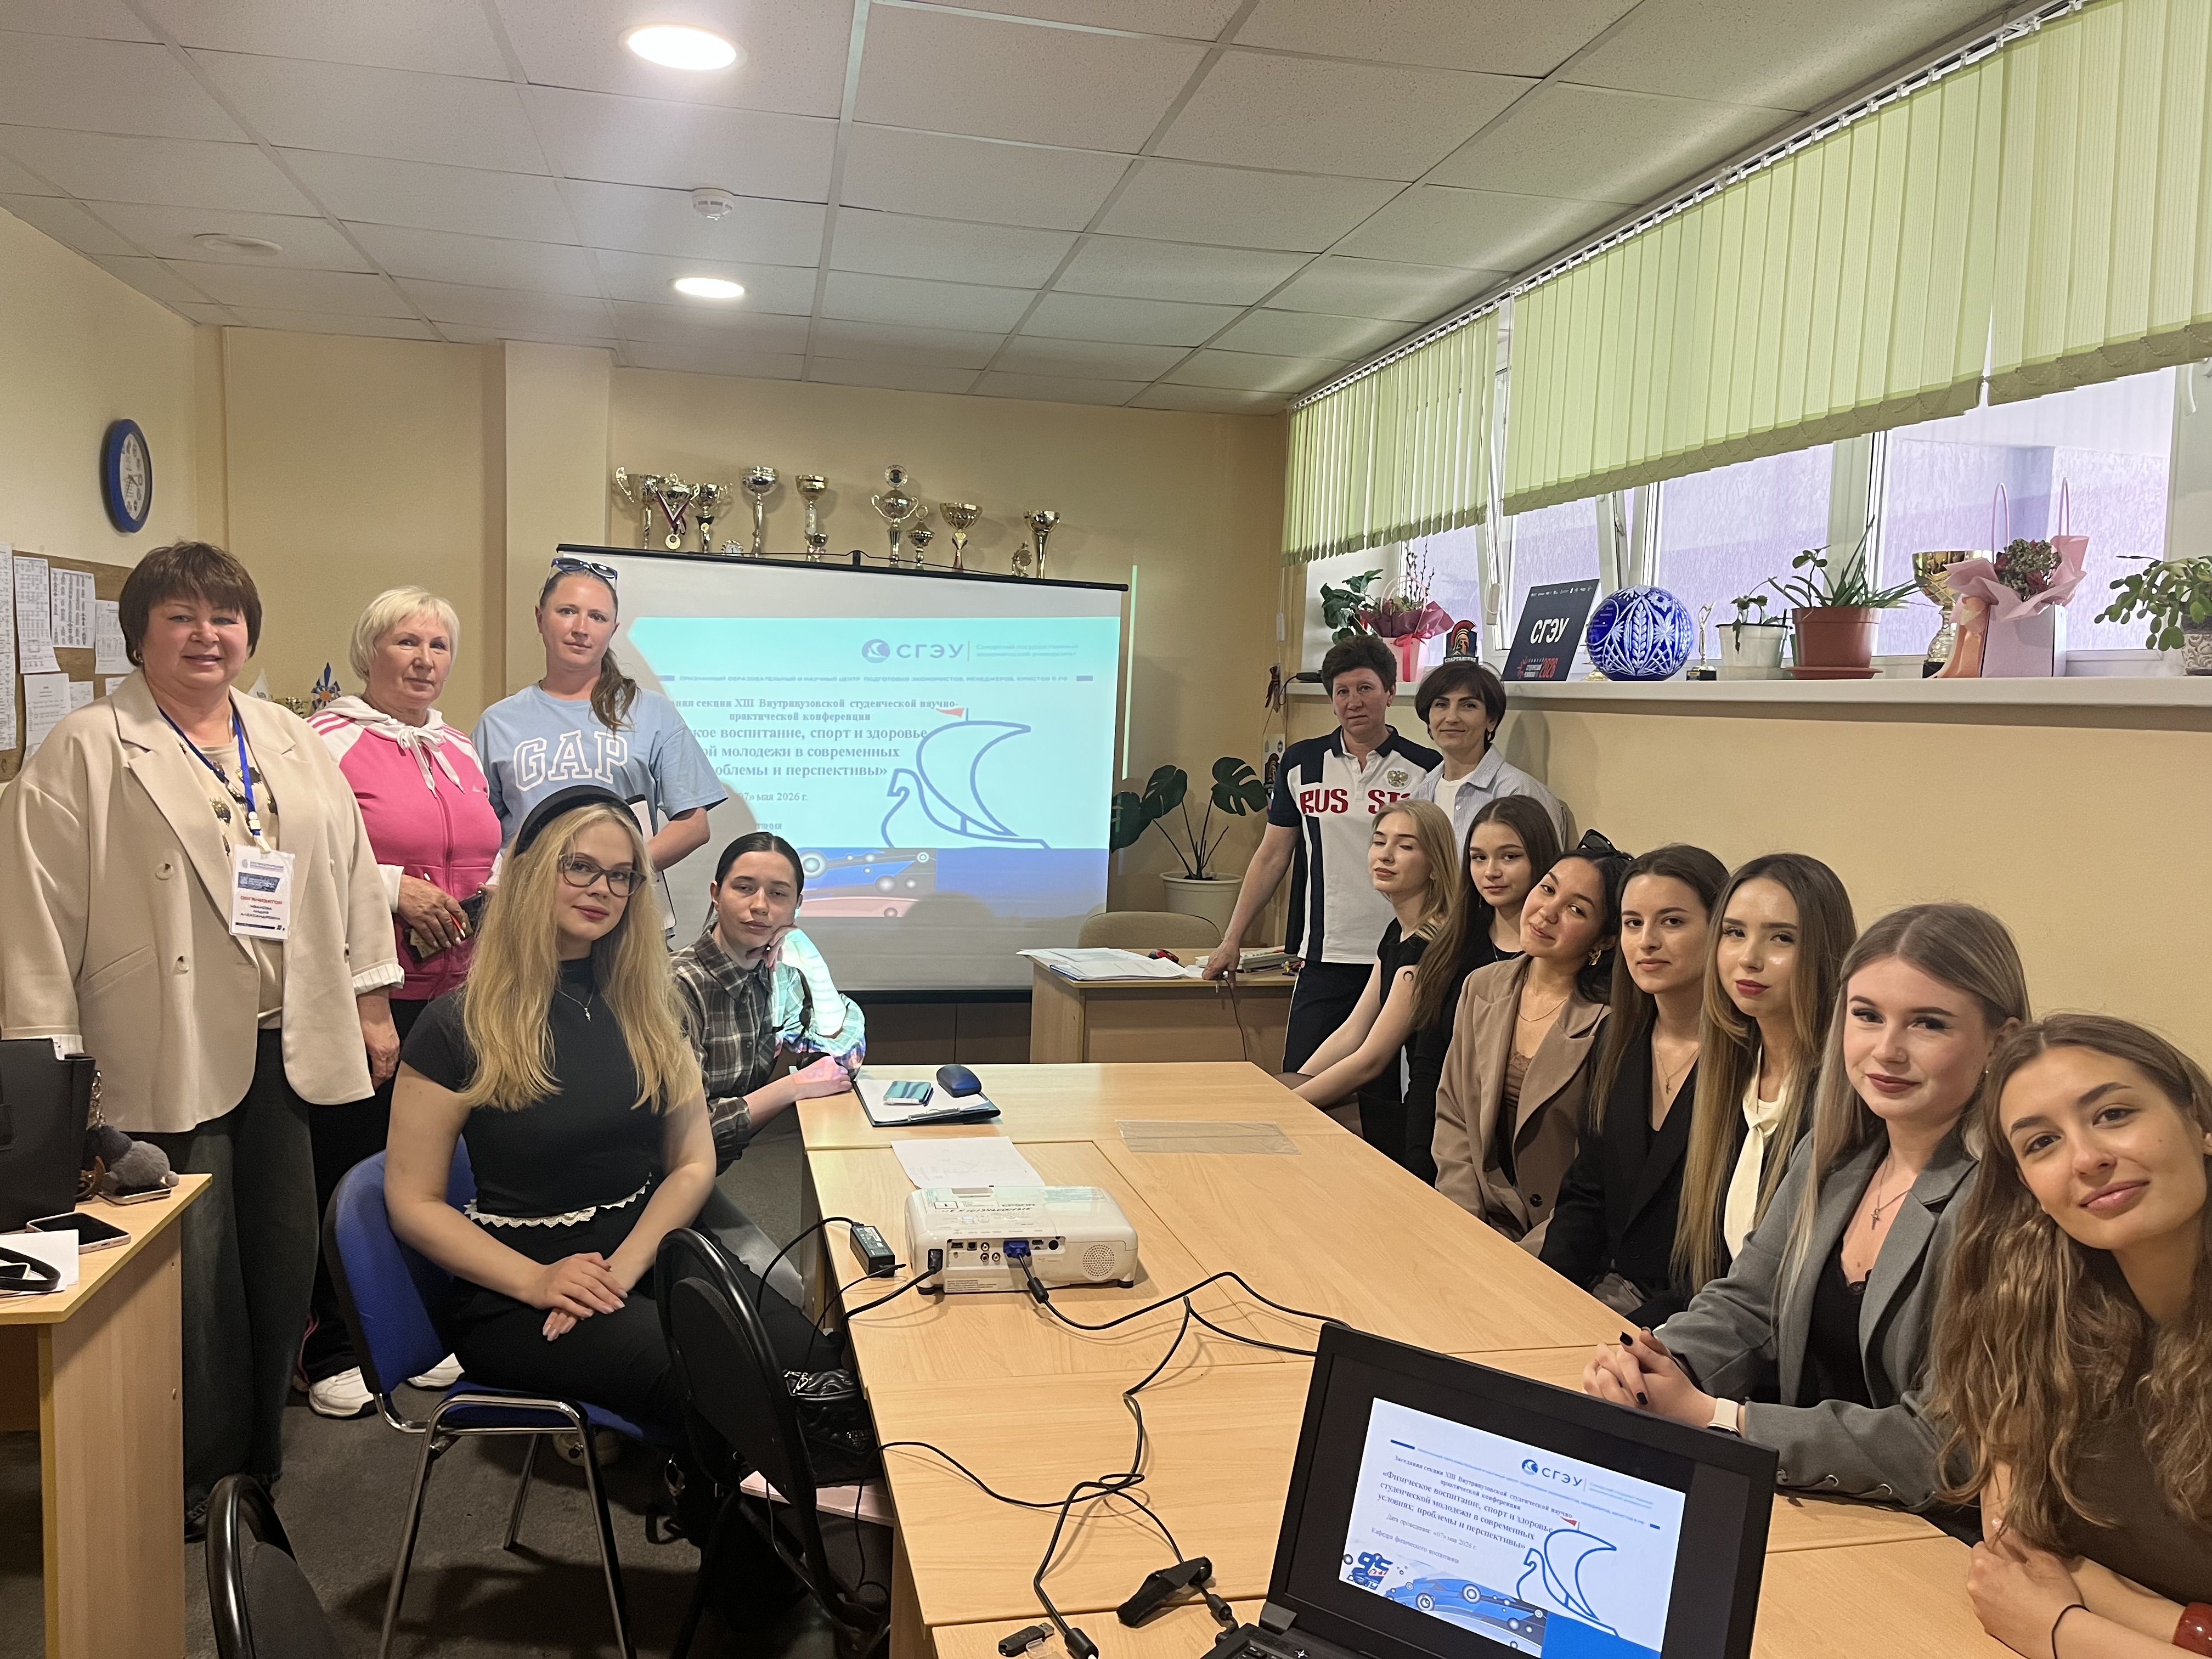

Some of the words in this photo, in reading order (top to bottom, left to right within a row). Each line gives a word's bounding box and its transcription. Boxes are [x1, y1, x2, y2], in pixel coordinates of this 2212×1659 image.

[1530, 618, 1570, 644] СГЭУ
[896, 644, 964, 658] СГЭУ
[759, 698, 844, 709] Внутривузовской
[850, 699, 916, 709] студенческой
[919, 701, 958, 709] научно-
[729, 712, 799, 722] практической
[803, 713, 871, 722] конференции
[720, 729, 805, 740] воспитание,
[810, 730, 851, 741] спорт
[854, 730, 862, 738] и
[866, 730, 927, 741] здоровье
[513, 730, 628, 792] GAP
[721, 748, 791, 758] молодежи
[795, 749, 804, 757] в
[807, 748, 900, 760] современных
[715, 764, 768, 776] облемы
[773, 767, 782, 775] и
[786, 766, 888, 778] перспективы»
[776, 793, 799, 801] 2026
[1395, 1455, 1423, 1469] Заседания
[1424, 1465, 1443, 1476] секции
[1458, 1476, 1508, 1497] Внутривузовской
[1509, 1494, 1549, 1511] студенческой
[1551, 1508, 1574, 1519] научно-
[1542, 1468, 1583, 1486] СГЭУ
[1383, 1471, 1432, 1492] «Физическое
[1434, 1488, 1481, 1510] воспитание,
[1484, 1505, 1508, 1518] спорт
[1516, 1516, 1553, 1533] здоровье
[1440, 1480, 1480, 1497] практической
[1481, 1493, 1521, 1511] конференции
[1380, 1482, 1431, 1504] студенческой
[1432, 1500, 1472, 1519] молодежи
[1480, 1516, 1535, 1541] современных
[1386, 1514, 1399, 1522] Дата
[1433, 1531, 1447, 1539] «07»
[1458, 1539, 1472, 1549] 2026
[1417, 1507, 1457, 1526] проблемы
[1466, 1524, 1526, 1549] перспективы»
[1372, 1527, 1393, 1541] Кафедра
[1394, 1536, 1427, 1553] физического
[1429, 1549, 1459, 1564] воспитания
